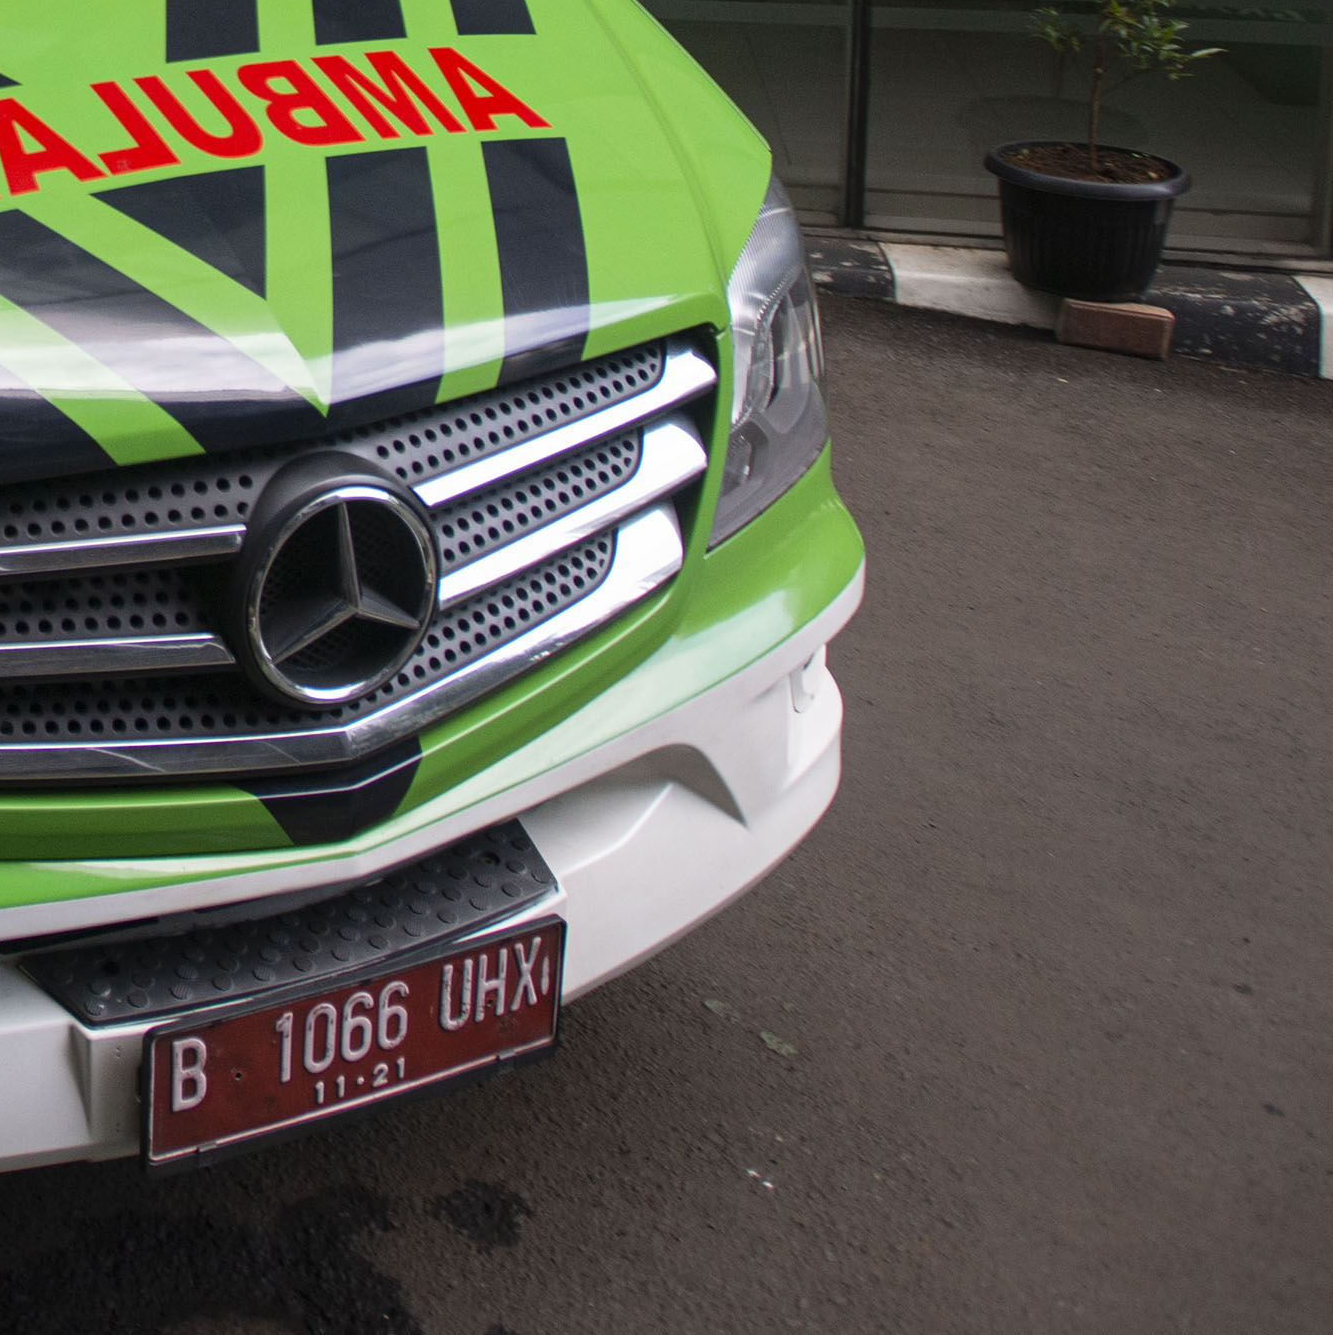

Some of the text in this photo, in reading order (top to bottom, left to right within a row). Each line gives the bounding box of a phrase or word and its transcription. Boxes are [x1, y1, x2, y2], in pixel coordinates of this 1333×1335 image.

[171, 936, 542, 1113] B 1066 UHX
